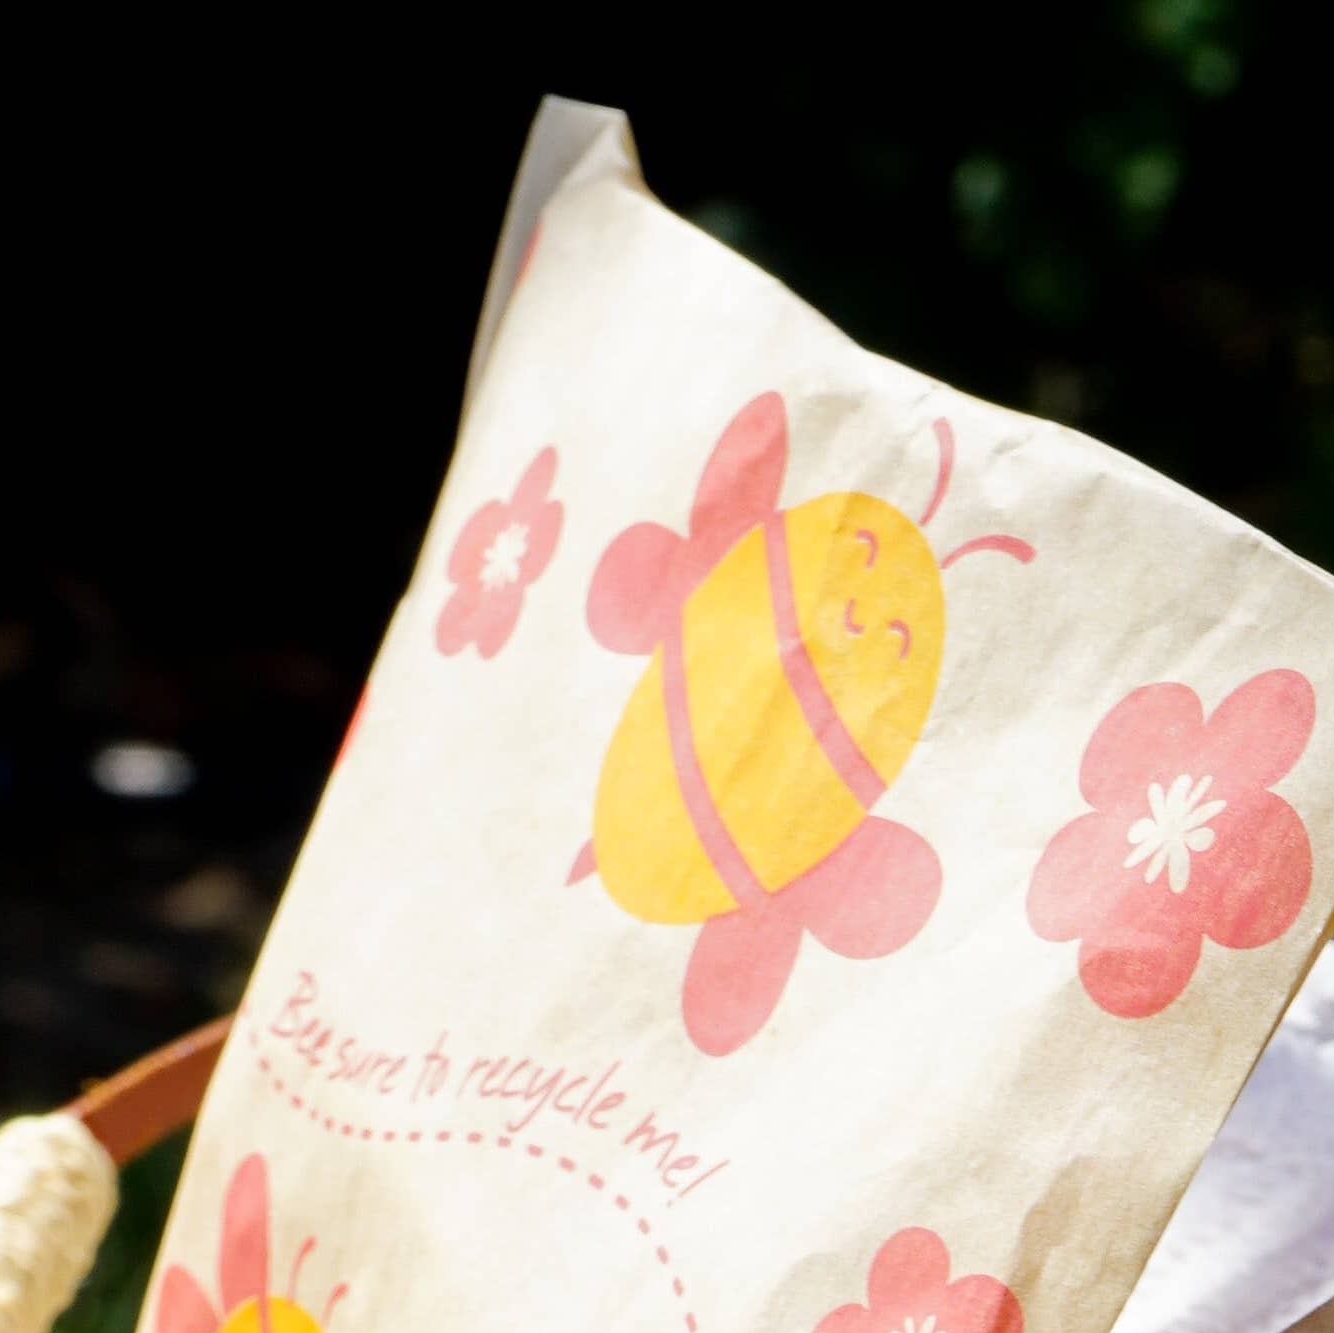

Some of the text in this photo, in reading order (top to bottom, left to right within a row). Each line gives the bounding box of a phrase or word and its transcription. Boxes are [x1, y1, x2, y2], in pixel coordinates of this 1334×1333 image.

[327, 1036, 409, 1095] sure
[410, 1028, 451, 1104] to
[455, 1054, 628, 1134] recycle
[623, 1110, 732, 1208] me!
